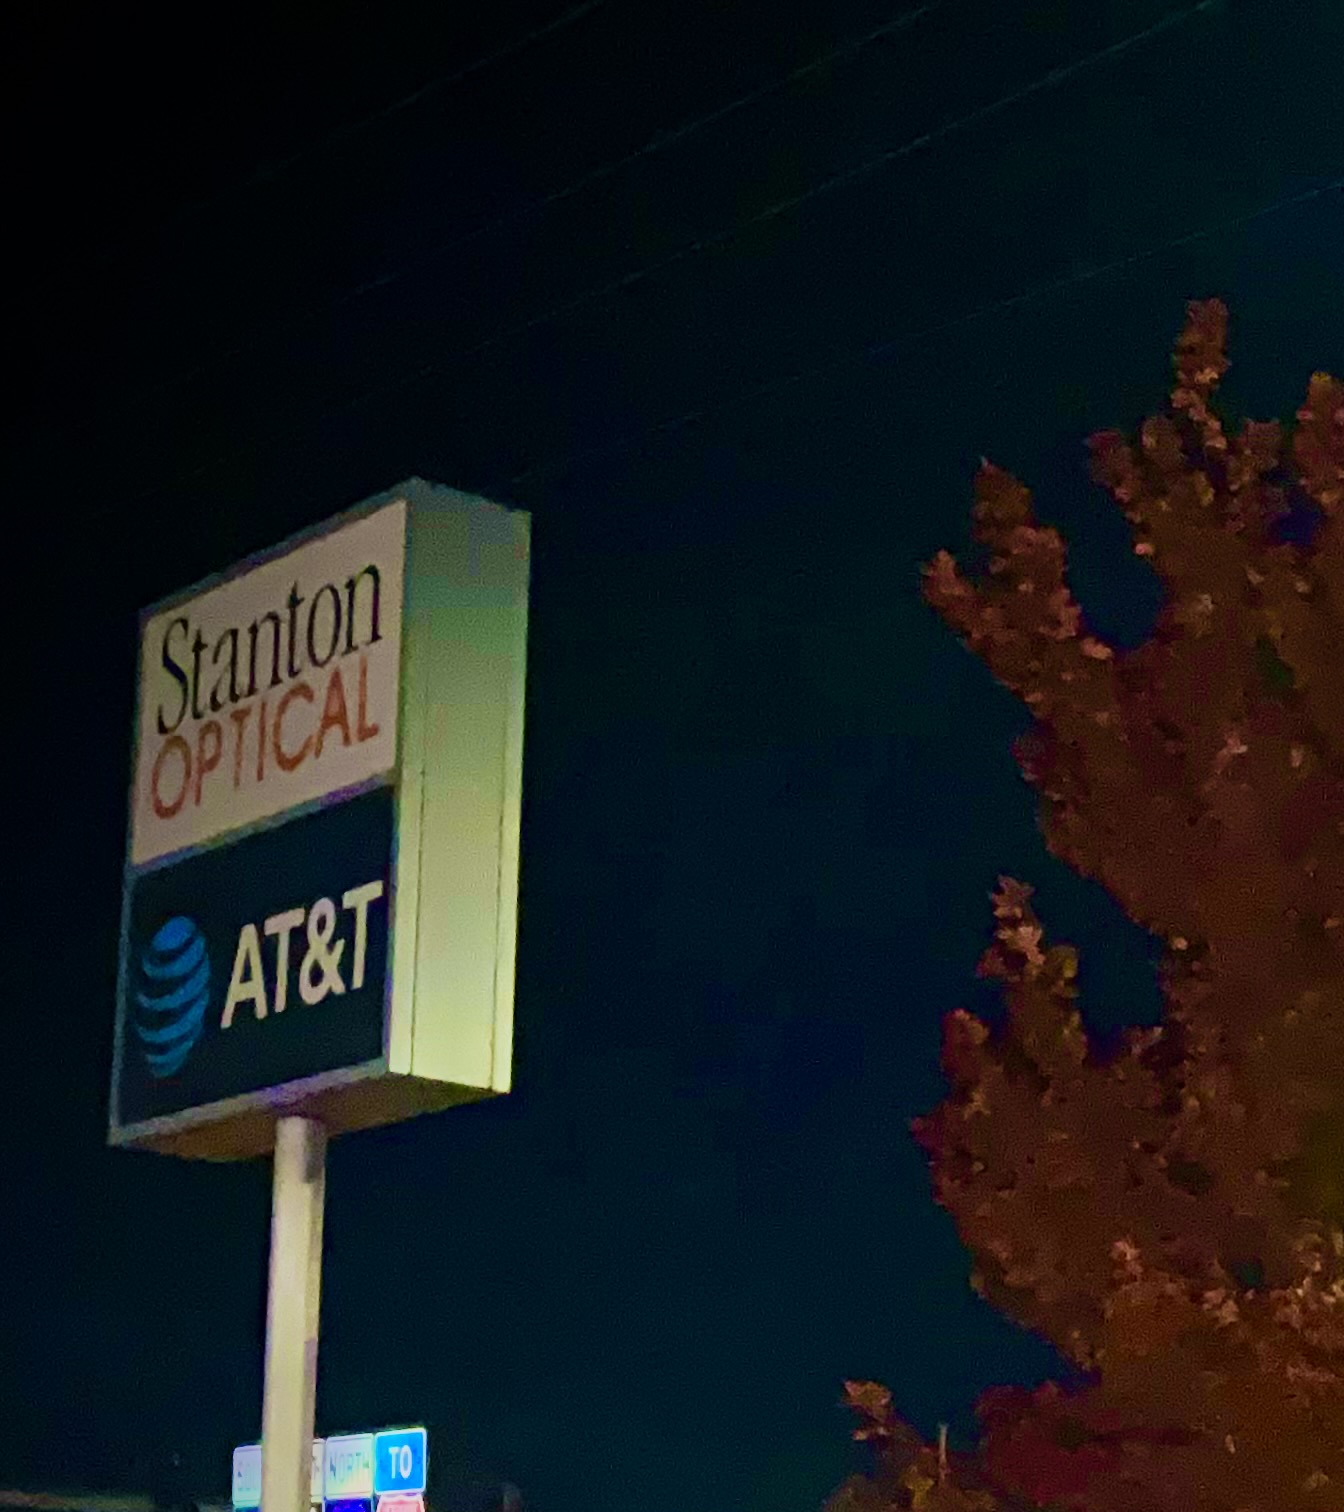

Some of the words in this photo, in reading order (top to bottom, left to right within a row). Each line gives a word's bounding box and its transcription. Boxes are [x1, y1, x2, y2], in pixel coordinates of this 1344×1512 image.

[157, 564, 382, 735] Stanton
[151, 656, 380, 819] OPTICAL
[220, 879, 384, 1029] AT&T
[388, 1445, 413, 1479] TO
